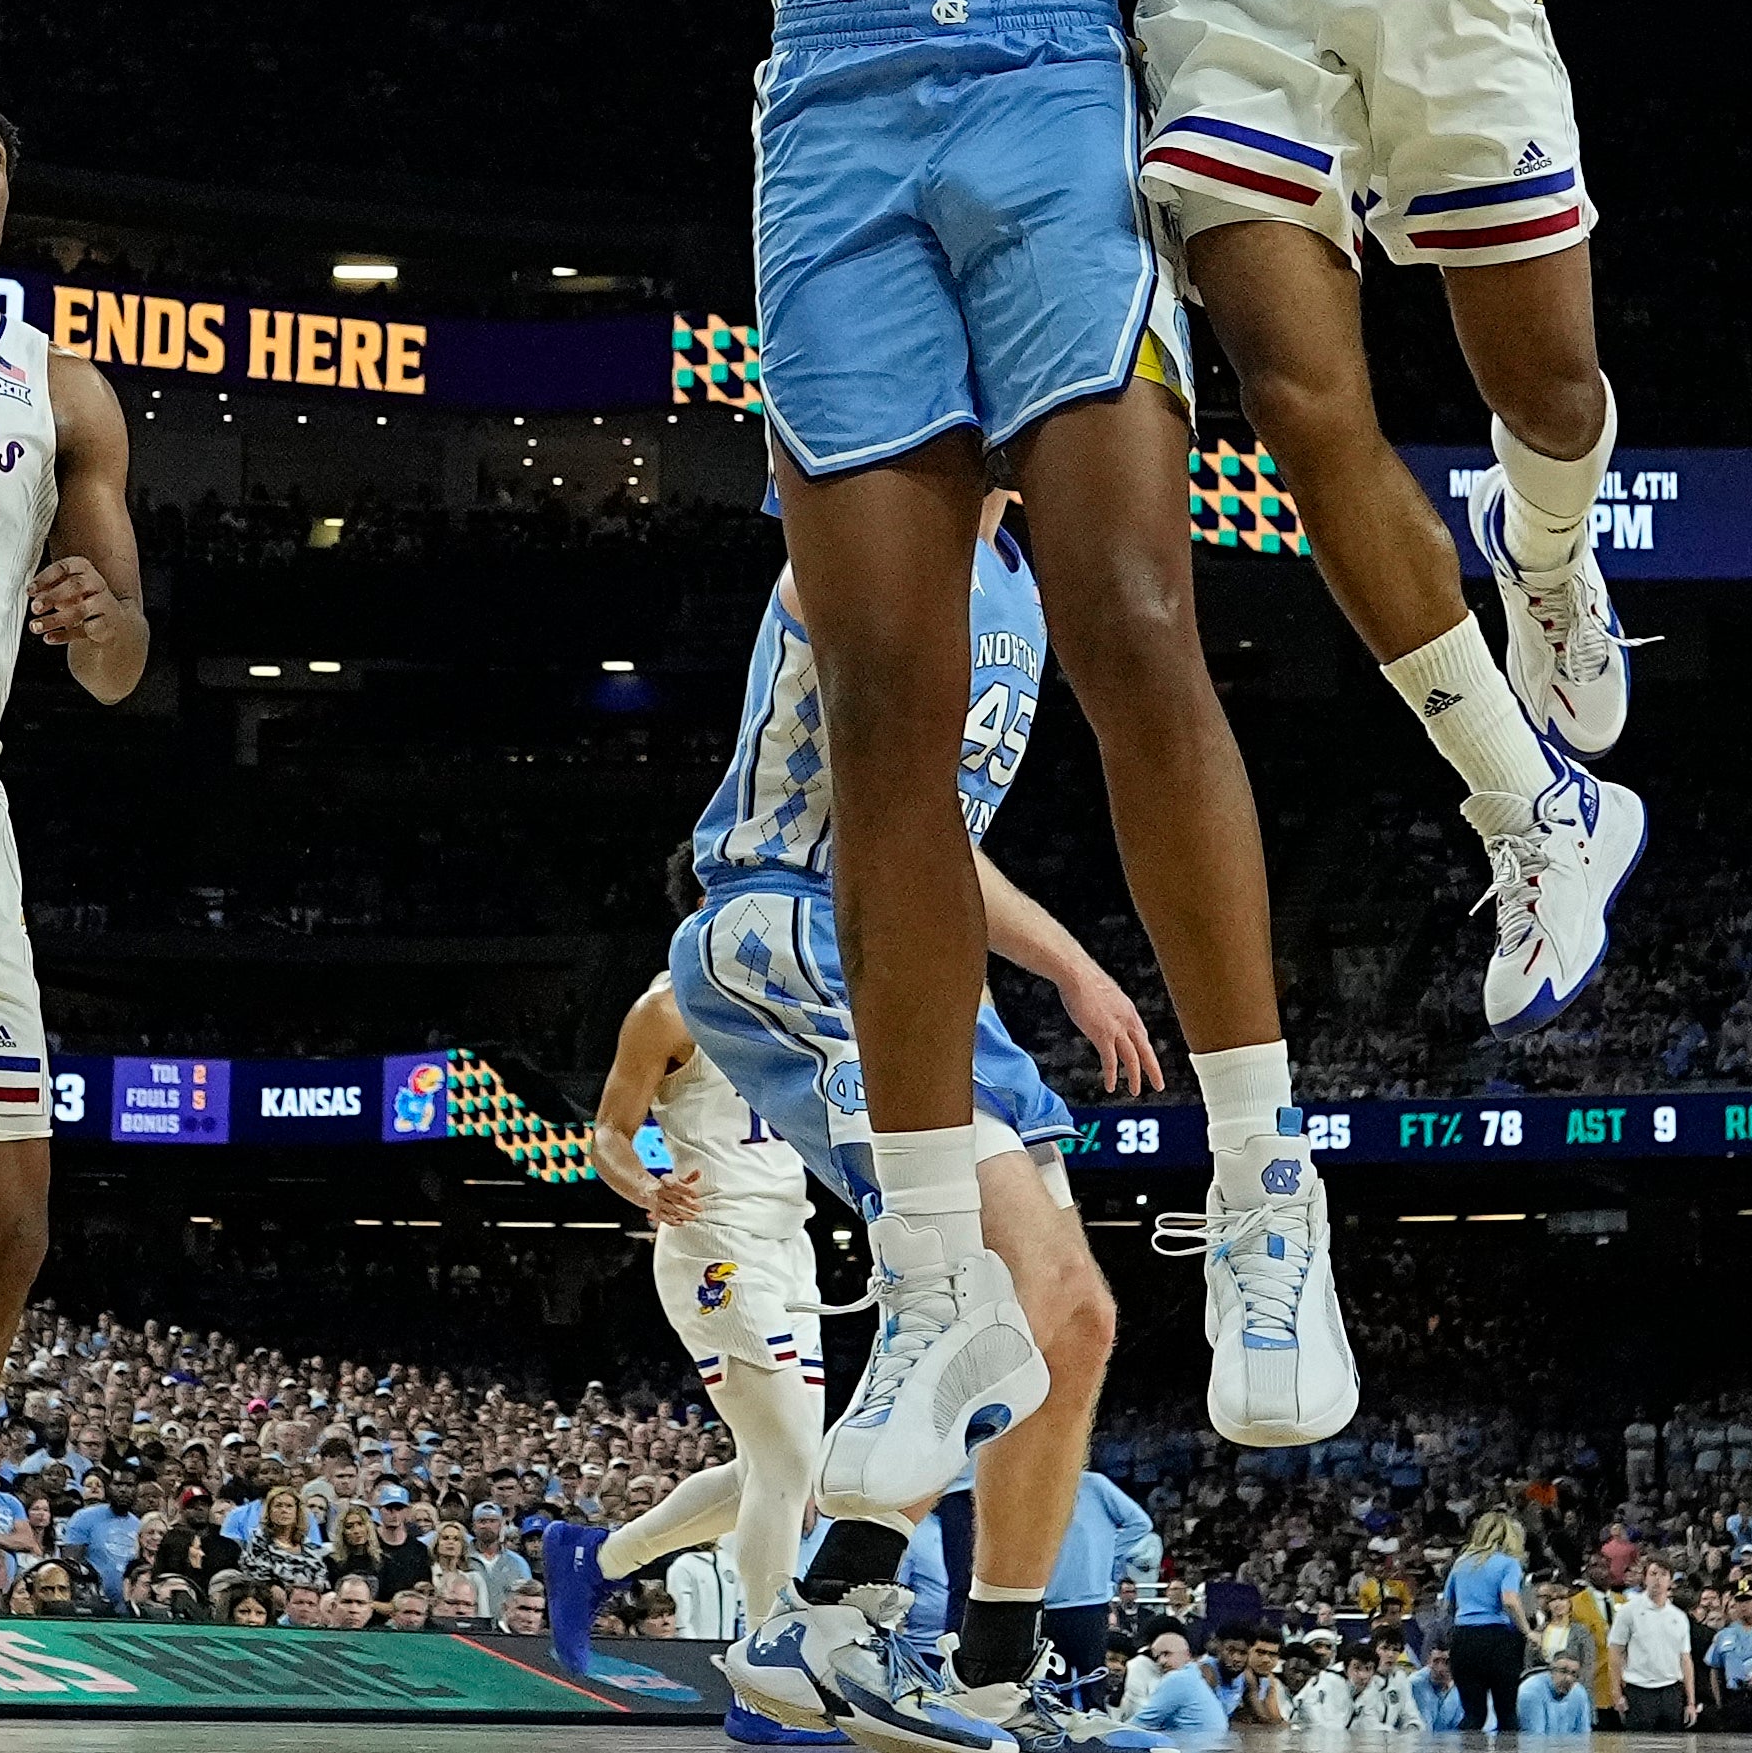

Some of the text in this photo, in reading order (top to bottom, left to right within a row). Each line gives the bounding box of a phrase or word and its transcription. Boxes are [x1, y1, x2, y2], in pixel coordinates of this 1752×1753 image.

[1513, 155, 1553, 177] adidas
[53, 286, 225, 373] ENDS
[248, 308, 427, 394] HERE
[1632, 472, 1678, 500] 4TH
[1588, 504, 1654, 550] PM
[975, 631, 1039, 685] NORTH
[960, 681, 1038, 788] 45
[151, 1064, 181, 1084] TOL
[46, 1074, 86, 1121] 3
[126, 1087, 180, 1109] FOULS
[261, 1087, 362, 1117] KANSAS
[120, 1113, 180, 1134] BONUS
[1116, 1119, 1160, 1154] 33
[1307, 1114, 1351, 1151] 25
[1400, 1111, 1462, 1148] FT%
[1479, 1110, 1523, 1147] 78
[1567, 1108, 1626, 1144] AST
[1654, 1106, 1677, 1142] 9
[69, 1633, 468, 1698] HERE
